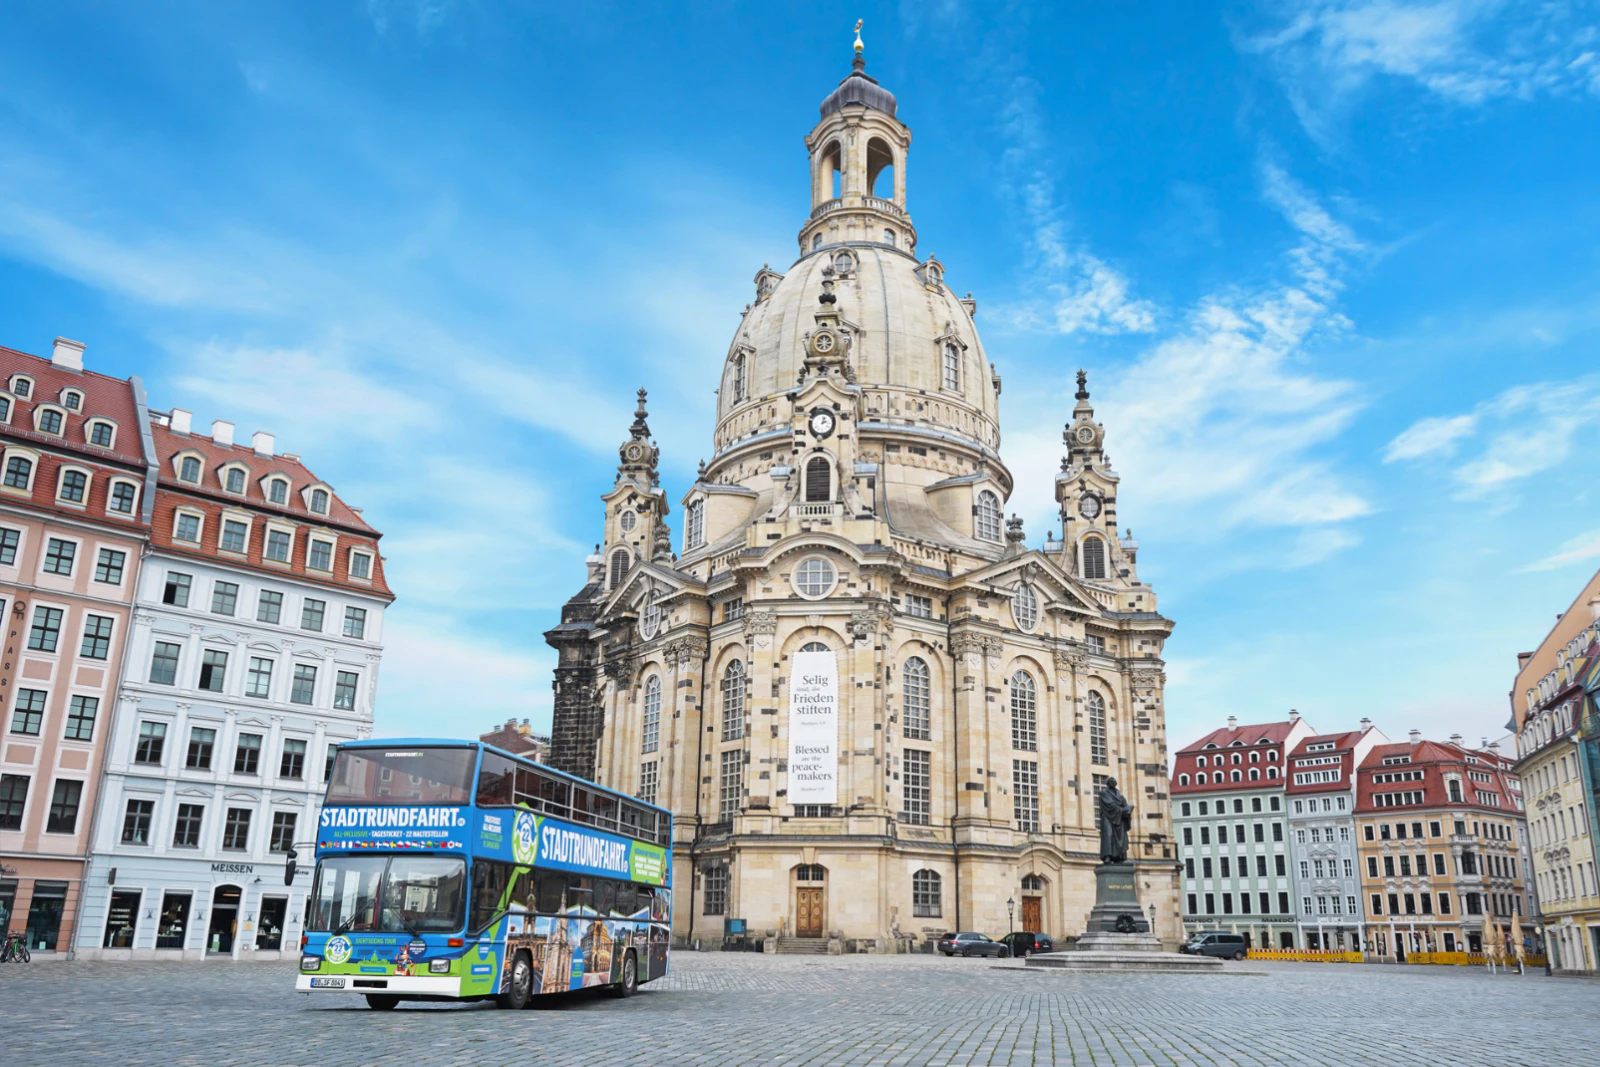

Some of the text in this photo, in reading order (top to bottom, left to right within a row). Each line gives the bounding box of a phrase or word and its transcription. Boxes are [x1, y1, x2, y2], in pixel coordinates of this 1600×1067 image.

[802, 675, 828, 687] Selig
[793, 693, 834, 703] Frieden
[796, 704, 832, 715] stiften
[795, 745, 830, 754] Blessed
[792, 764, 823, 773] peace-
[797, 771, 832, 781] makers
[211, 863, 254, 874] MEISSEN
[334, 944, 343, 952] 22
